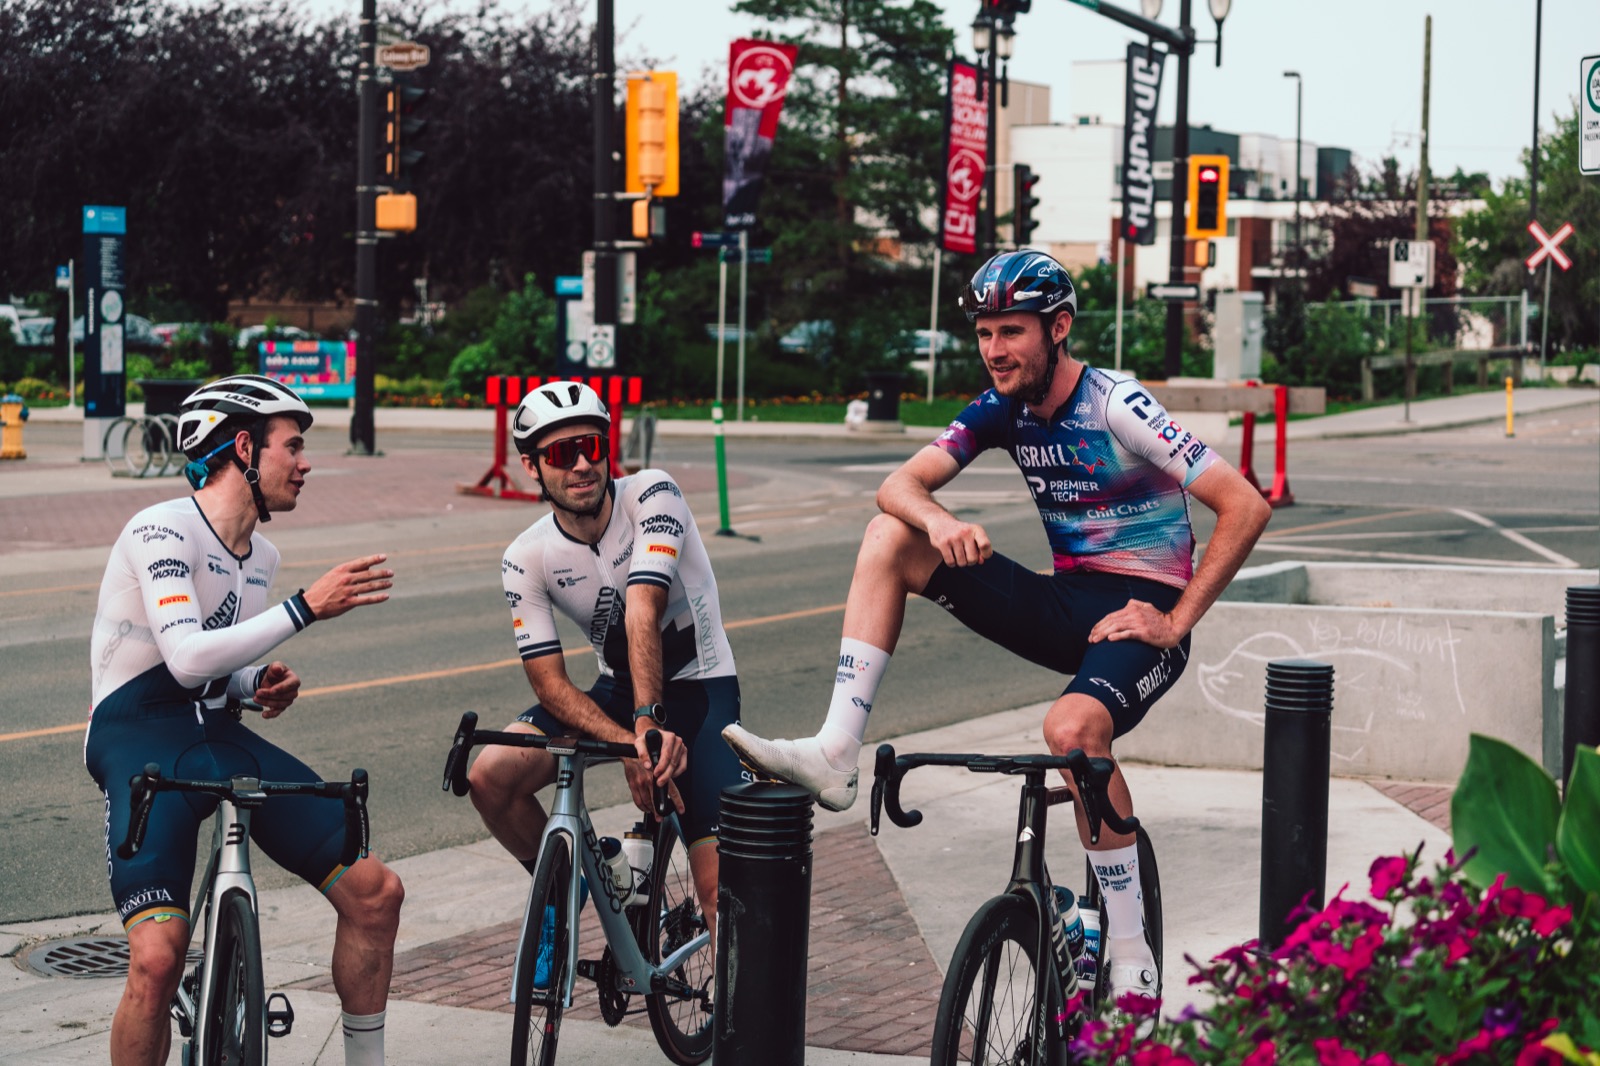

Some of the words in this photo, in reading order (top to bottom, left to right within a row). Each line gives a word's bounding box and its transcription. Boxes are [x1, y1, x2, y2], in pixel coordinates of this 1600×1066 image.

[225, 393, 261, 408] LAZER
[1147, 411, 1166, 428] PREMI
[184, 435, 199, 447] LAZER
[1016, 443, 1070, 467] ISRAEL
[640, 483, 667, 503] ABACUS
[1050, 480, 1100, 491] PREMIER
[1051, 492, 1079, 502] TECH
[1087, 505, 1117, 519] Chit
[1117, 499, 1160, 515] Chats
[640, 514, 683, 534] TORONTO
[643, 525, 680, 538] HUSTLE
[132, 524, 155, 535] PUCK'S
[157, 525, 185, 542] LODGE
[142, 531, 167, 543] Cycling
[147, 558, 190, 574] TORONTO
[502, 559, 525, 575] ODGE
[152, 568, 186, 581] HUSTLE
[202, 590, 237, 631] ONTO
[590, 586, 615, 646] TORONTO
[160, 618, 197, 634] JAKROO
[691, 594, 720, 676] MAGNOTTA
[838, 654, 854, 669] AEL
[1136, 664, 1162, 702] ISRAEL
[104, 788, 113, 880] TORONTO
[584, 827, 622, 914] BASSO
[1095, 864, 1127, 876] ISRAEL
[1110, 877, 1132, 886] PREMIER
[118, 887, 174, 918] AGNOTTA
